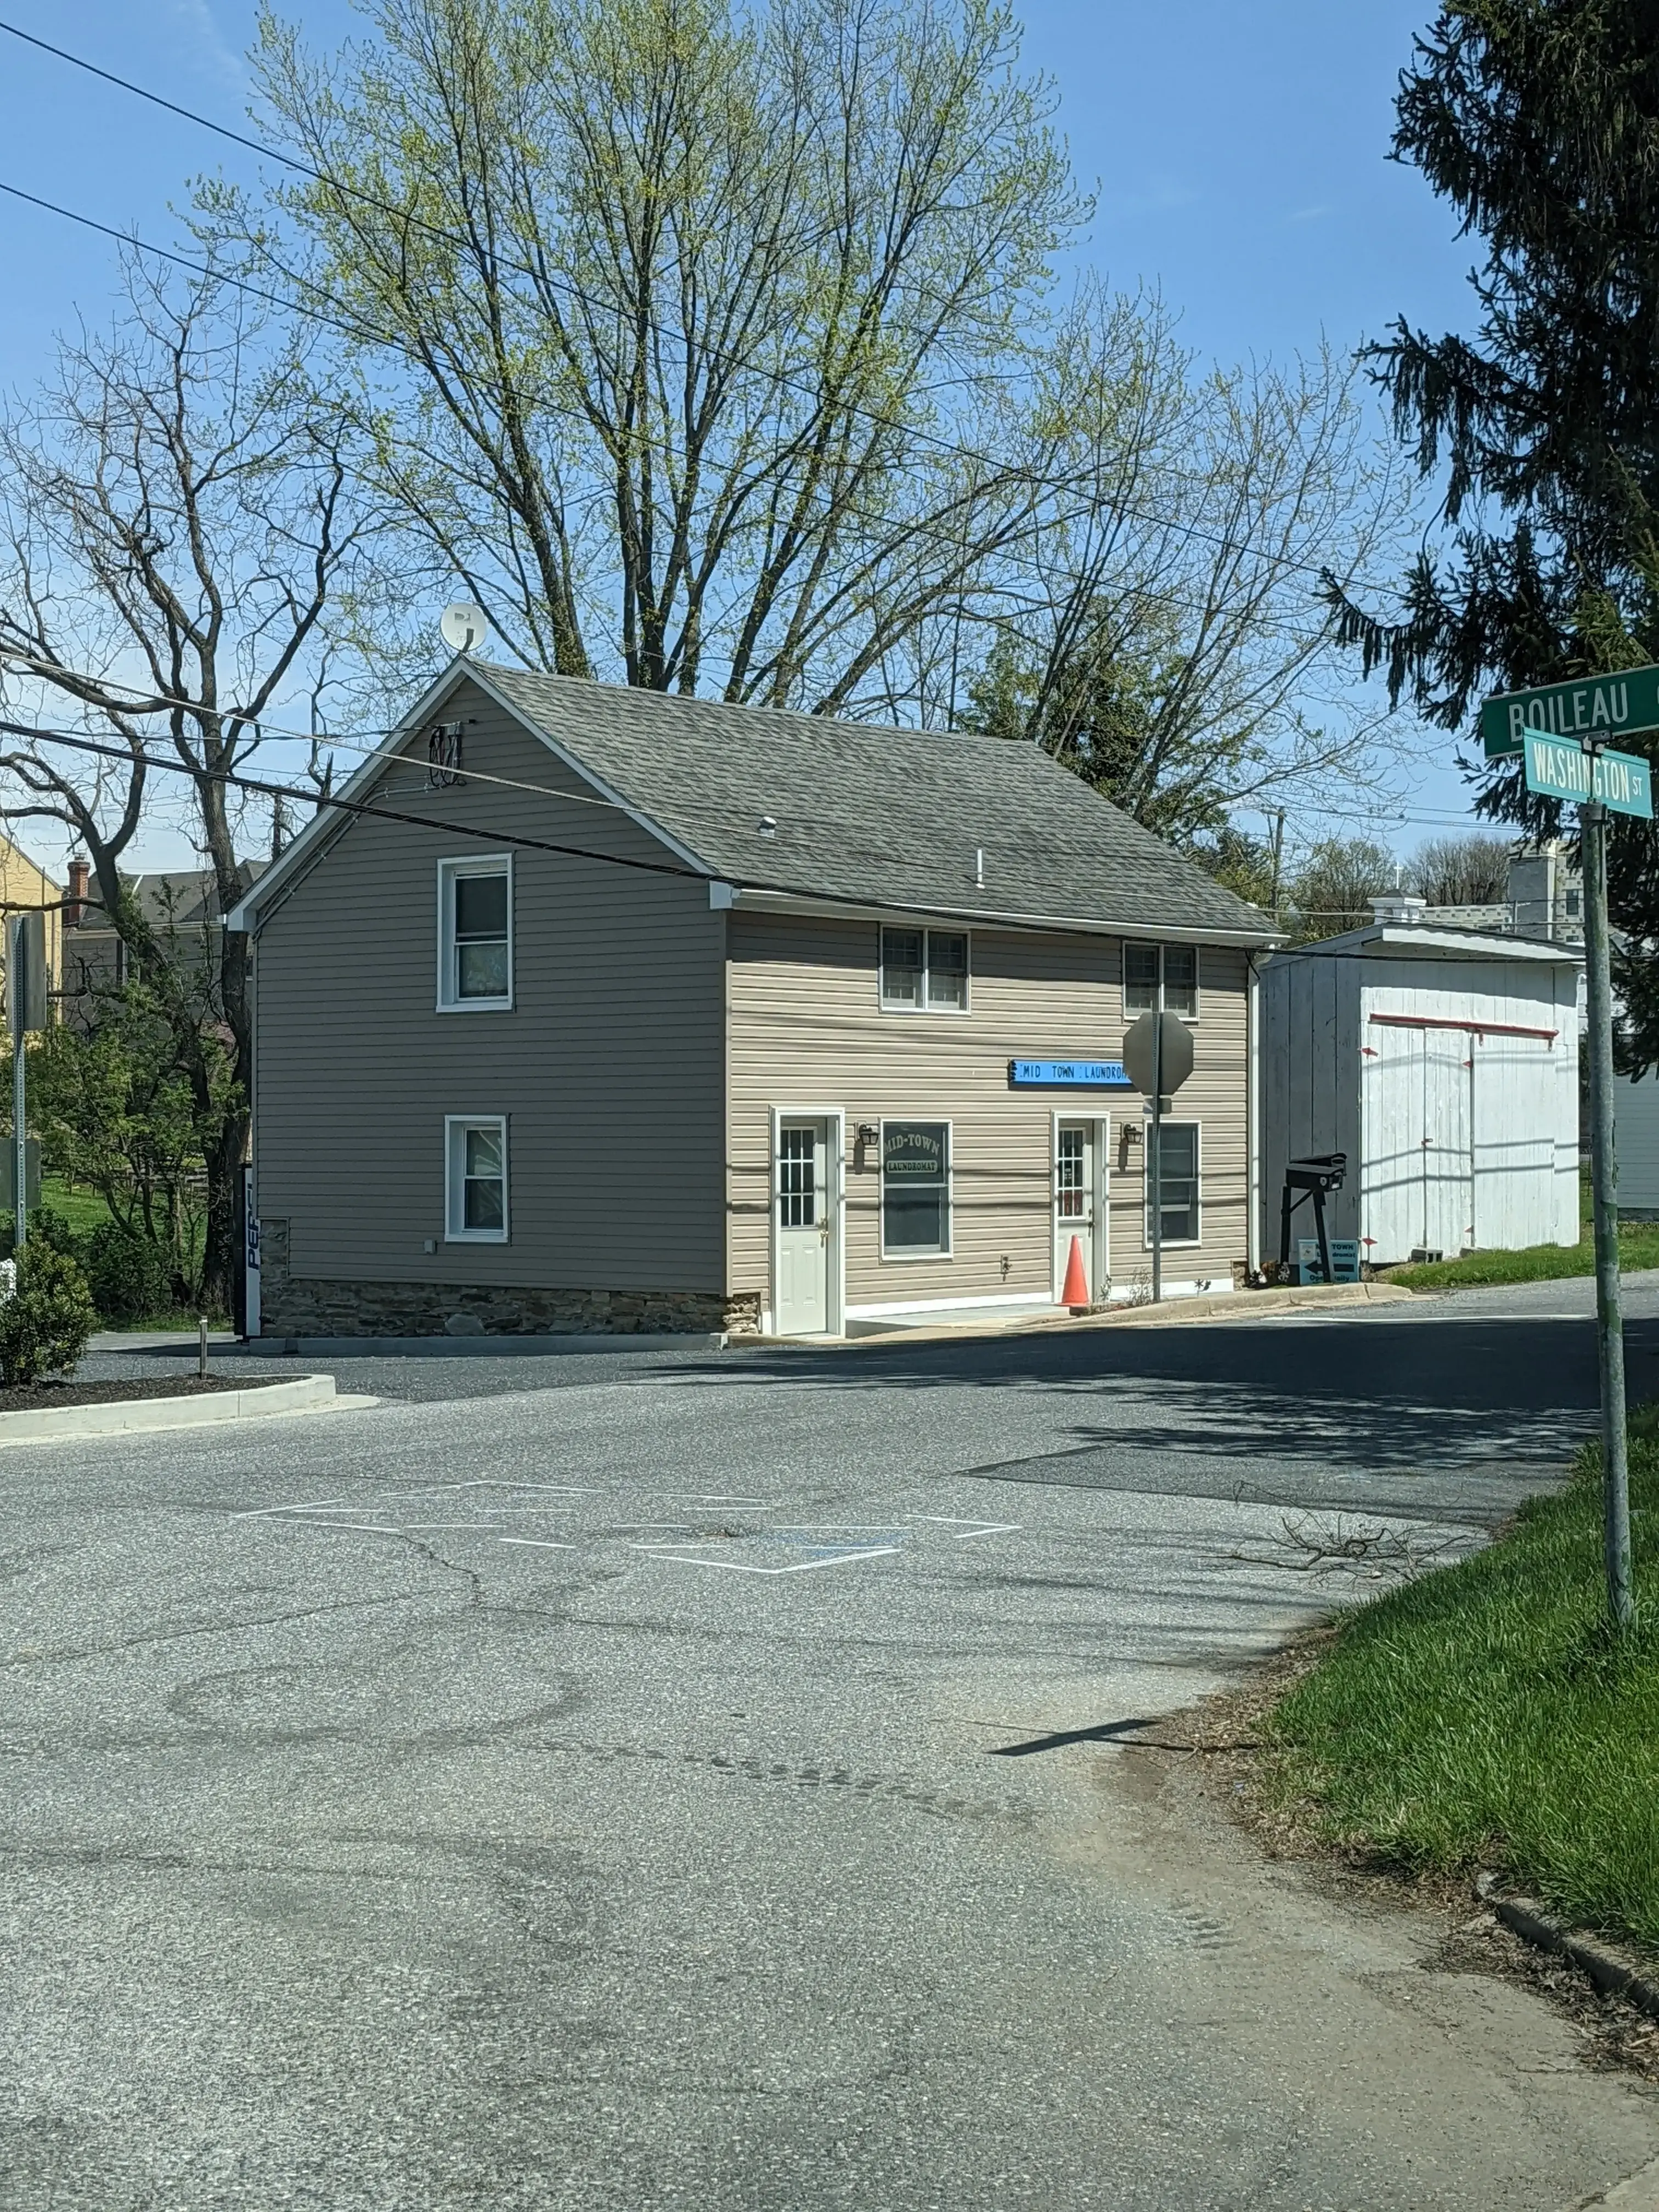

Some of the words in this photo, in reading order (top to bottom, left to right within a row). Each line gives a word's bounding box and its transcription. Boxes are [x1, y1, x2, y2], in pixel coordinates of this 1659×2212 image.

[1509, 682, 1628, 742] BOILEAU
[1533, 742, 1630, 803] WASHINGTON
[1633, 776, 1643, 796] ST
[1023, 1065, 1041, 1078] MID
[1052, 1065, 1074, 1079] TOWN
[1085, 1066, 1126, 1080] LAUNDRO
[884, 1134, 940, 1156] MID-TOWN
